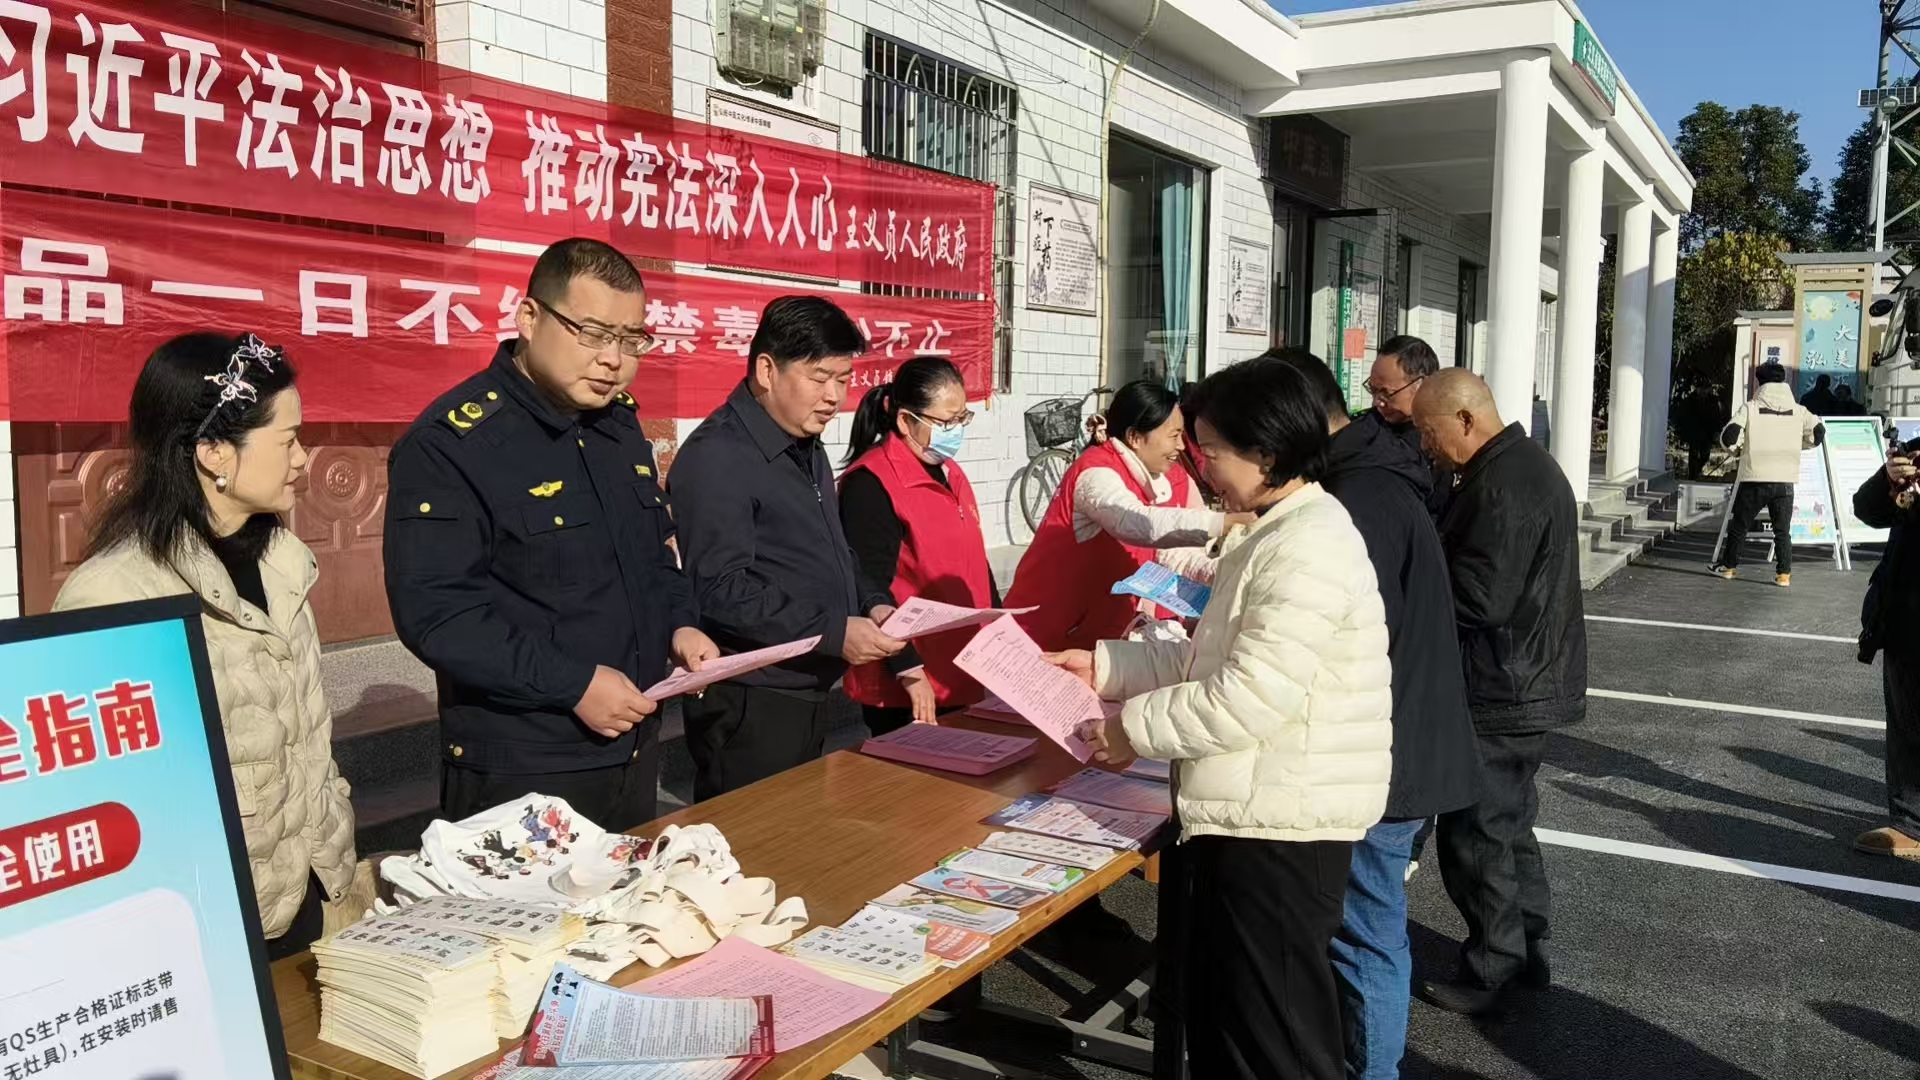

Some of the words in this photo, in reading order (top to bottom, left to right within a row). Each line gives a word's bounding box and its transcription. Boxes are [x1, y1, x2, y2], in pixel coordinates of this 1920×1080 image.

[0, 0, 493, 204] 习近平法治思想
[521, 109, 838, 252] 推动宪法深入人心
[845, 204, 968, 272] 王义贞人民政府
[3, 237, 520, 346] 品一日不
